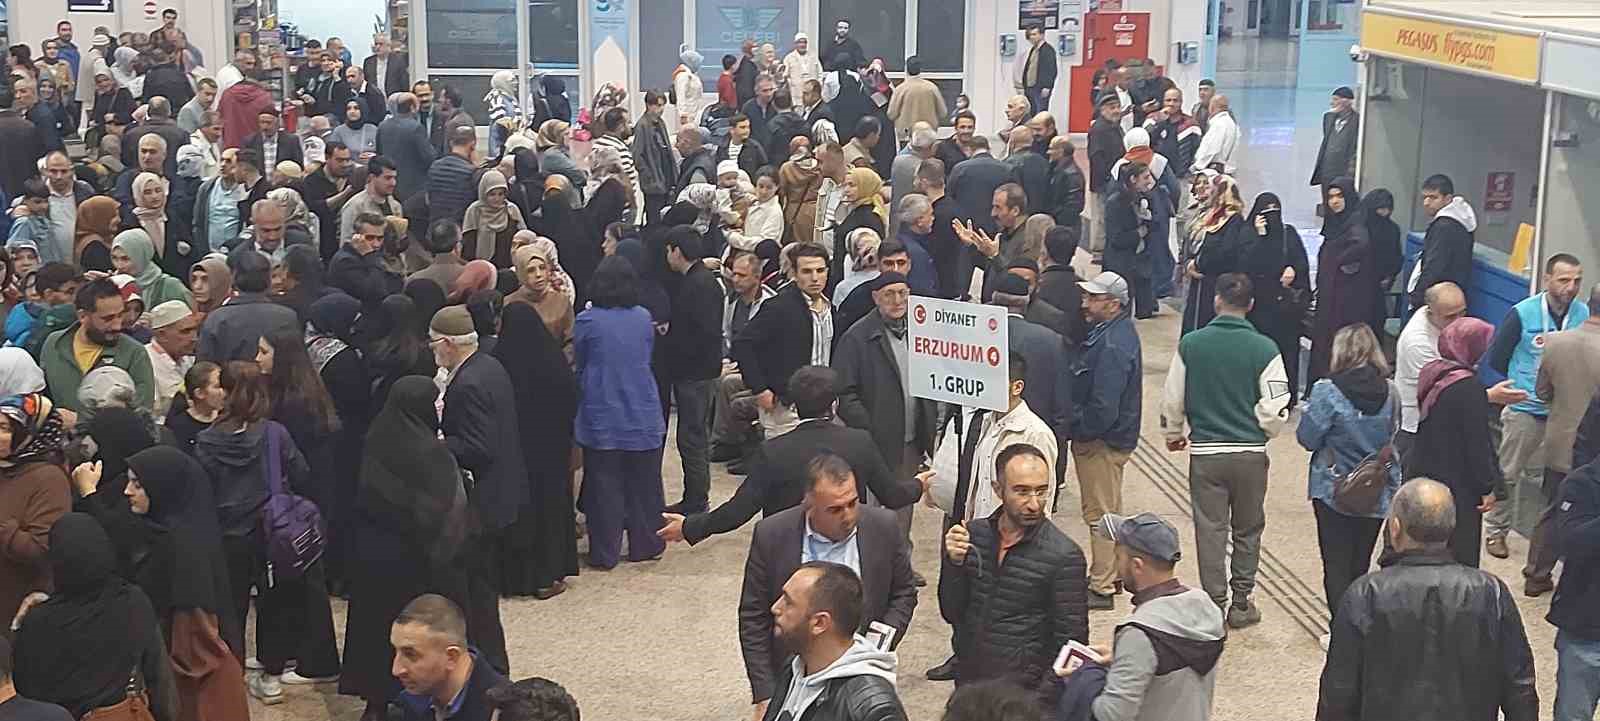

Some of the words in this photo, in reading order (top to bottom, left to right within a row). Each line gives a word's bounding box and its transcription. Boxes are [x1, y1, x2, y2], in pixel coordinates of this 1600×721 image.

[1397, 29, 1440, 54] PEGASUS
[935, 308, 977, 327] DİYANET
[915, 336, 984, 363] ERZURUM
[929, 373, 942, 391] 1.
[945, 375, 985, 397] GRUP
